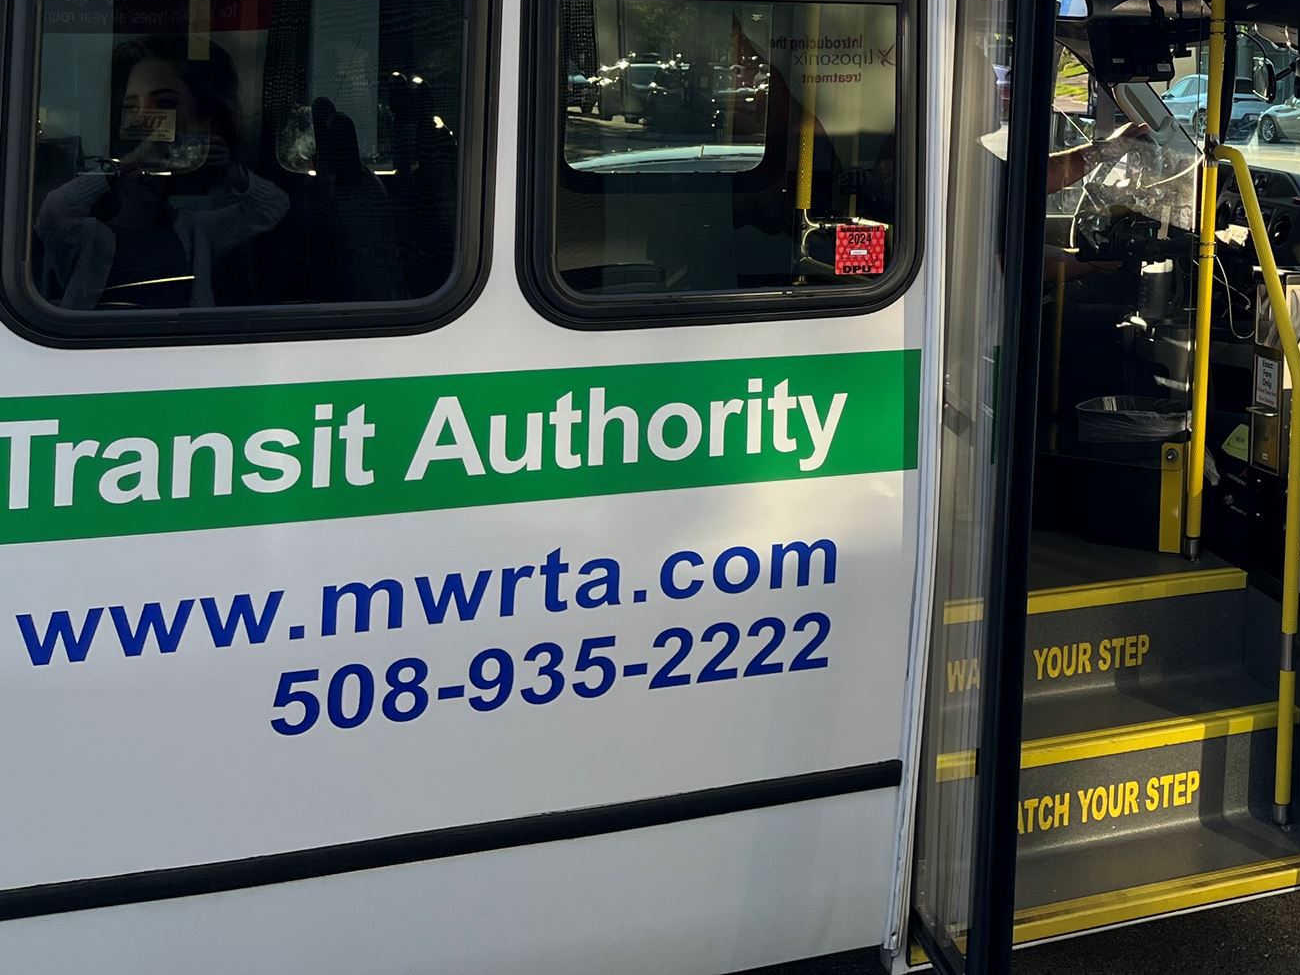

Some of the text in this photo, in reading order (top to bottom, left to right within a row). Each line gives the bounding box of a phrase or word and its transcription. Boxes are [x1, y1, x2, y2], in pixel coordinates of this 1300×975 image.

[848, 233, 872, 244] 2024
[0, 377, 848, 510] Transit Authority
[16, 537, 838, 666] www.mwrta.com
[270, 611, 832, 736] 508-935-2222
[1033, 633, 1150, 681] YOUR STEP
[1017, 770, 1200, 835] TCH YOUR STEP
